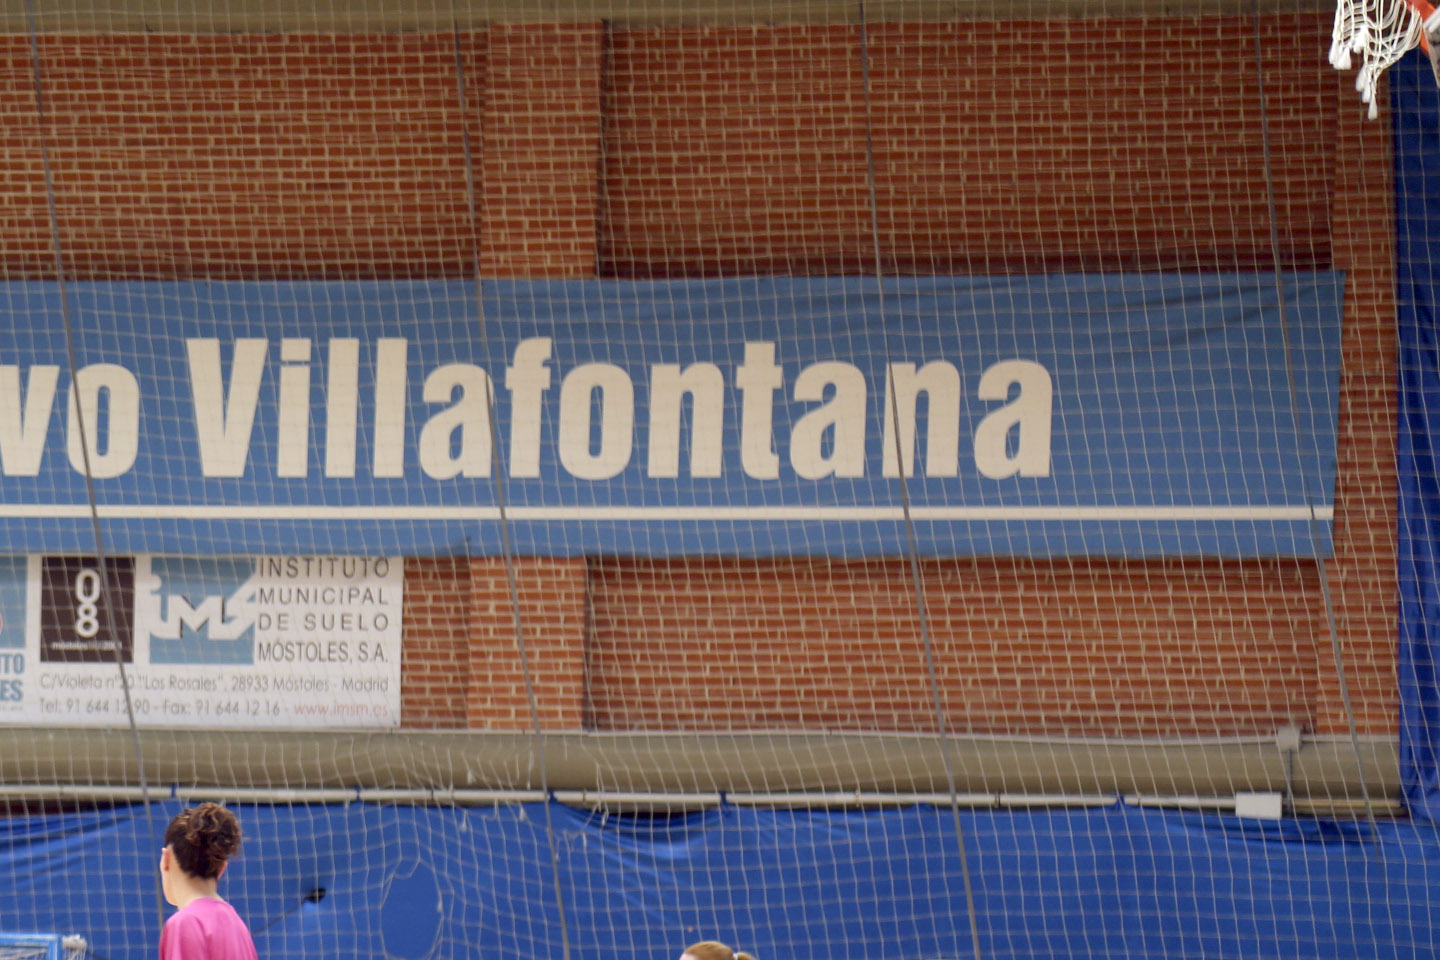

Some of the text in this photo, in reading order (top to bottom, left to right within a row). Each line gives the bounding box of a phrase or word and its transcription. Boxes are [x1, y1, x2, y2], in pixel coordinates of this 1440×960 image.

[186, 335, 1053, 481] Villafontana
[260, 557, 389, 578] INSTITUTO
[259, 586, 389, 606] MUNICIPAL
[259, 613, 389, 632] DE SUELO
[258, 638, 388, 664] MÓSTOLES, S.A.
[231, 674, 269, 692] 28933
[342, 675, 389, 692] Madrid
[66, 697, 80, 713] 91
[86, 699, 110, 714] 644
[195, 699, 210, 716] 91
[216, 700, 240, 717] 644
[246, 699, 261, 717] 12
[265, 699, 281, 717] 16
